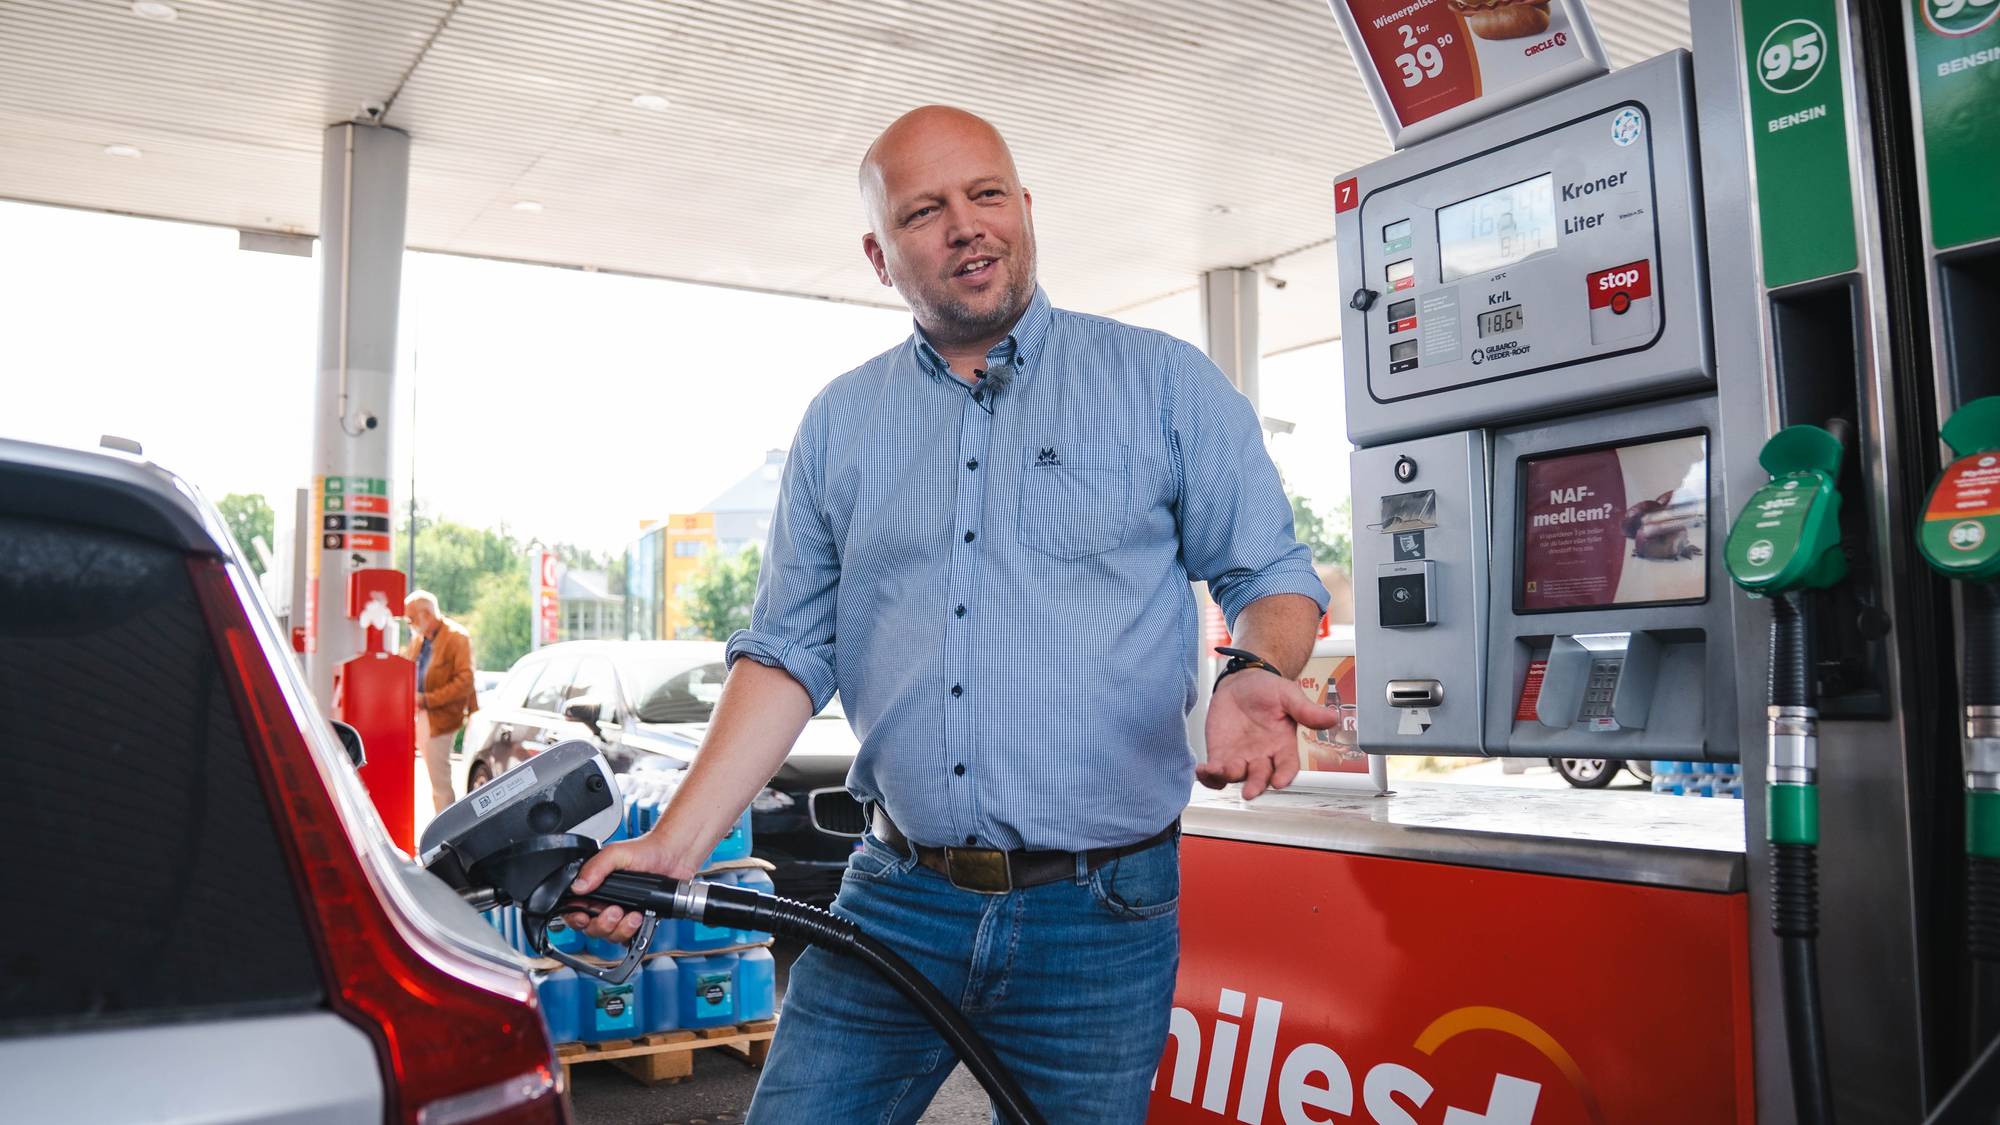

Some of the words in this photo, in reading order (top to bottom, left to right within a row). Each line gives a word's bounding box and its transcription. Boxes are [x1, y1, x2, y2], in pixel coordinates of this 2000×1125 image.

[1398, 24, 1418, 49] 2
[1416, 24, 1430, 34] for
[1525, 39, 1554, 57] CIRCLE
[1555, 33, 1566, 45] K
[1395, 44, 1444, 88] 39
[1437, 34, 1454, 48] 90
[1762, 32, 1821, 81] 95
[1768, 104, 1827, 133] BENSIN
[1342, 186, 1351, 203] 7
[1561, 170, 1628, 202] Kroner
[1564, 212, 1605, 235] Liter
[1600, 269, 1639, 291] stop
[1488, 290, 1512, 305] Kr/L
[1485, 340, 1518, 354] GILBARCO
[1486, 346, 1531, 362] VEEDER-ROOT
[1550, 486, 1595, 505] NAF-
[1533, 503, 1613, 527] medlem?
